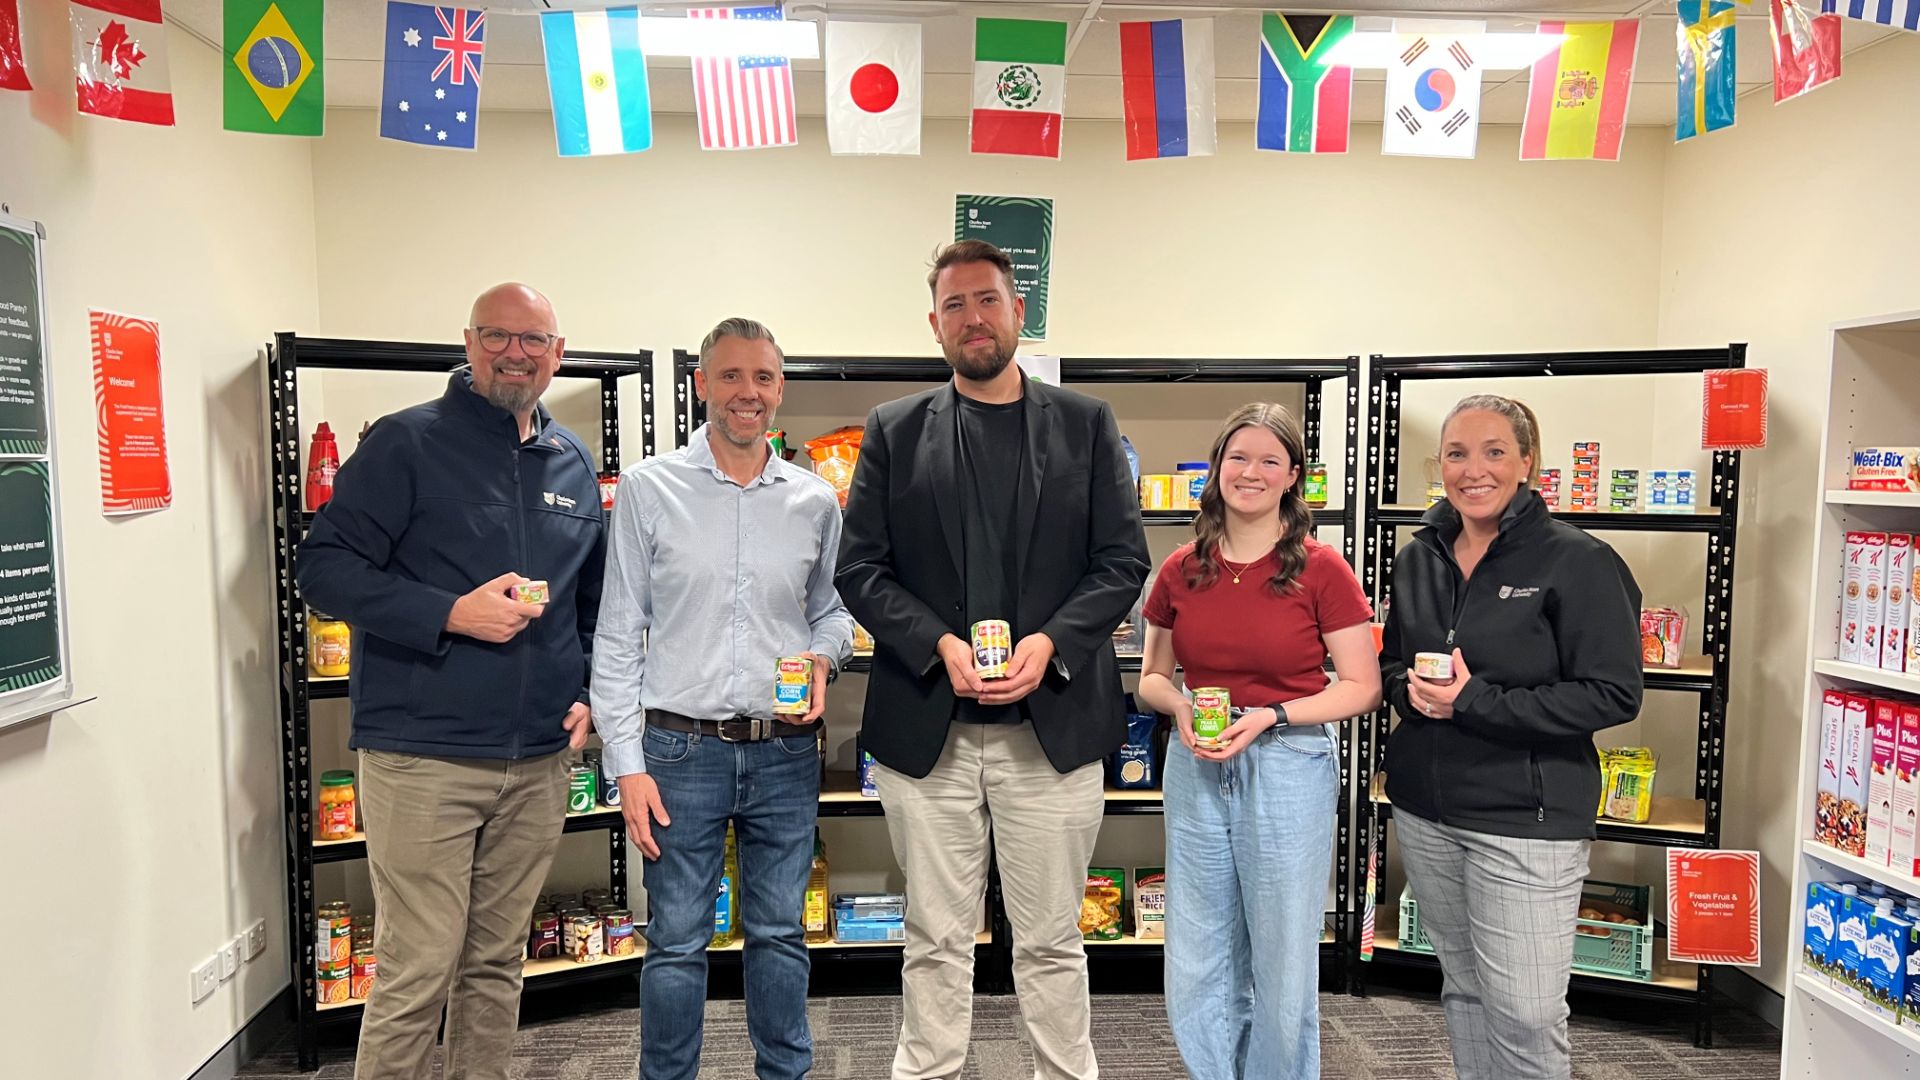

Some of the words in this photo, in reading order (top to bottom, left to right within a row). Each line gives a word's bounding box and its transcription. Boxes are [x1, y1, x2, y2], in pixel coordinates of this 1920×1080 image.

[9, 302, 28, 315] Pantry?
[109, 377, 135, 388] Welcome!
[1854, 452, 1904, 467] Weet-Bix
[1857, 467, 1879, 475] Gluten
[1880, 467, 1896, 476] Free
[13, 542, 25, 551] what
[25, 543, 34, 552] you
[34, 540, 45, 548] need
[22, 568, 31, 577] per
[32, 564, 50, 576] person)
[4, 594, 19, 603] kinds
[19, 592, 24, 601] of
[25, 590, 38, 600] foods
[38, 591, 46, 599] you
[0, 606, 13, 615] ually
[38, 600, 48, 608] have
[0, 616, 17, 626] nough
[25, 611, 46, 620] everyone.
[1876, 724, 1892, 738] Plus
[1902, 730, 1918, 745] Plus
[1851, 724, 1860, 763] SPECIAL
[1141, 894, 1165, 903] FRIED
[1689, 892, 1712, 900] Fresh
[1693, 901, 1735, 910] Vegetables
[1810, 912, 1820, 921] LITE
[1820, 917, 1831, 926] MILK
[1843, 926, 1854, 934] LITE
[1870, 944, 1881, 952] LITE
[1882, 948, 1895, 957] MILK
